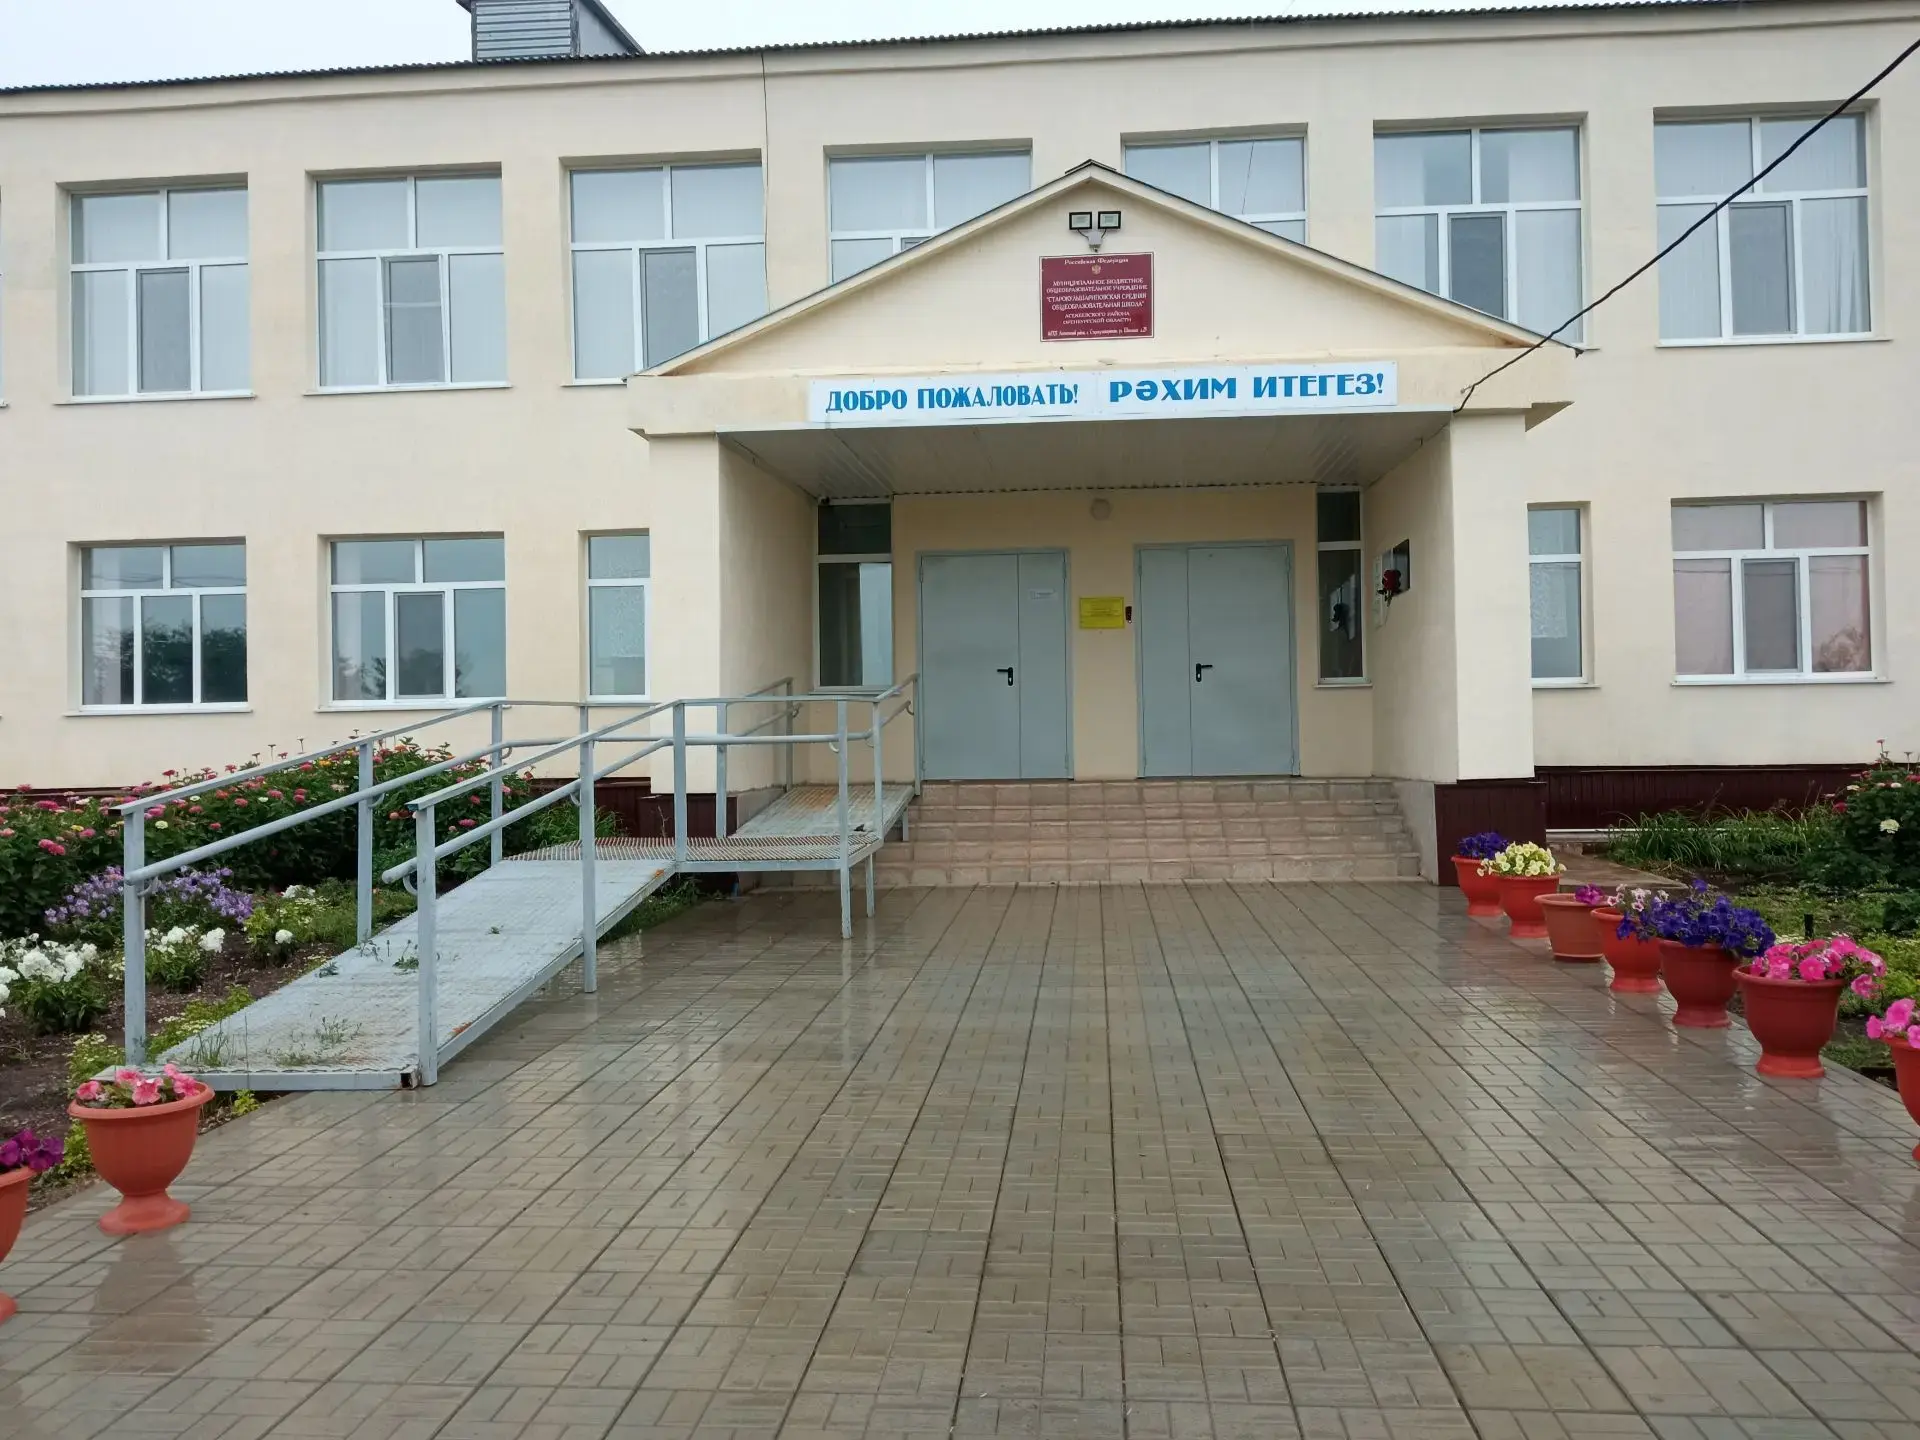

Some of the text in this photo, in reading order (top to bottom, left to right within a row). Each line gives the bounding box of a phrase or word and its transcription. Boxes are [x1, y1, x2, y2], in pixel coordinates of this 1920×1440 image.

[826, 383, 1079, 414] ДОБРО ПОЖАЛОВАТЬ!
[1109, 372, 1384, 403] РӘХИМ ИТЕГЕЗ!
